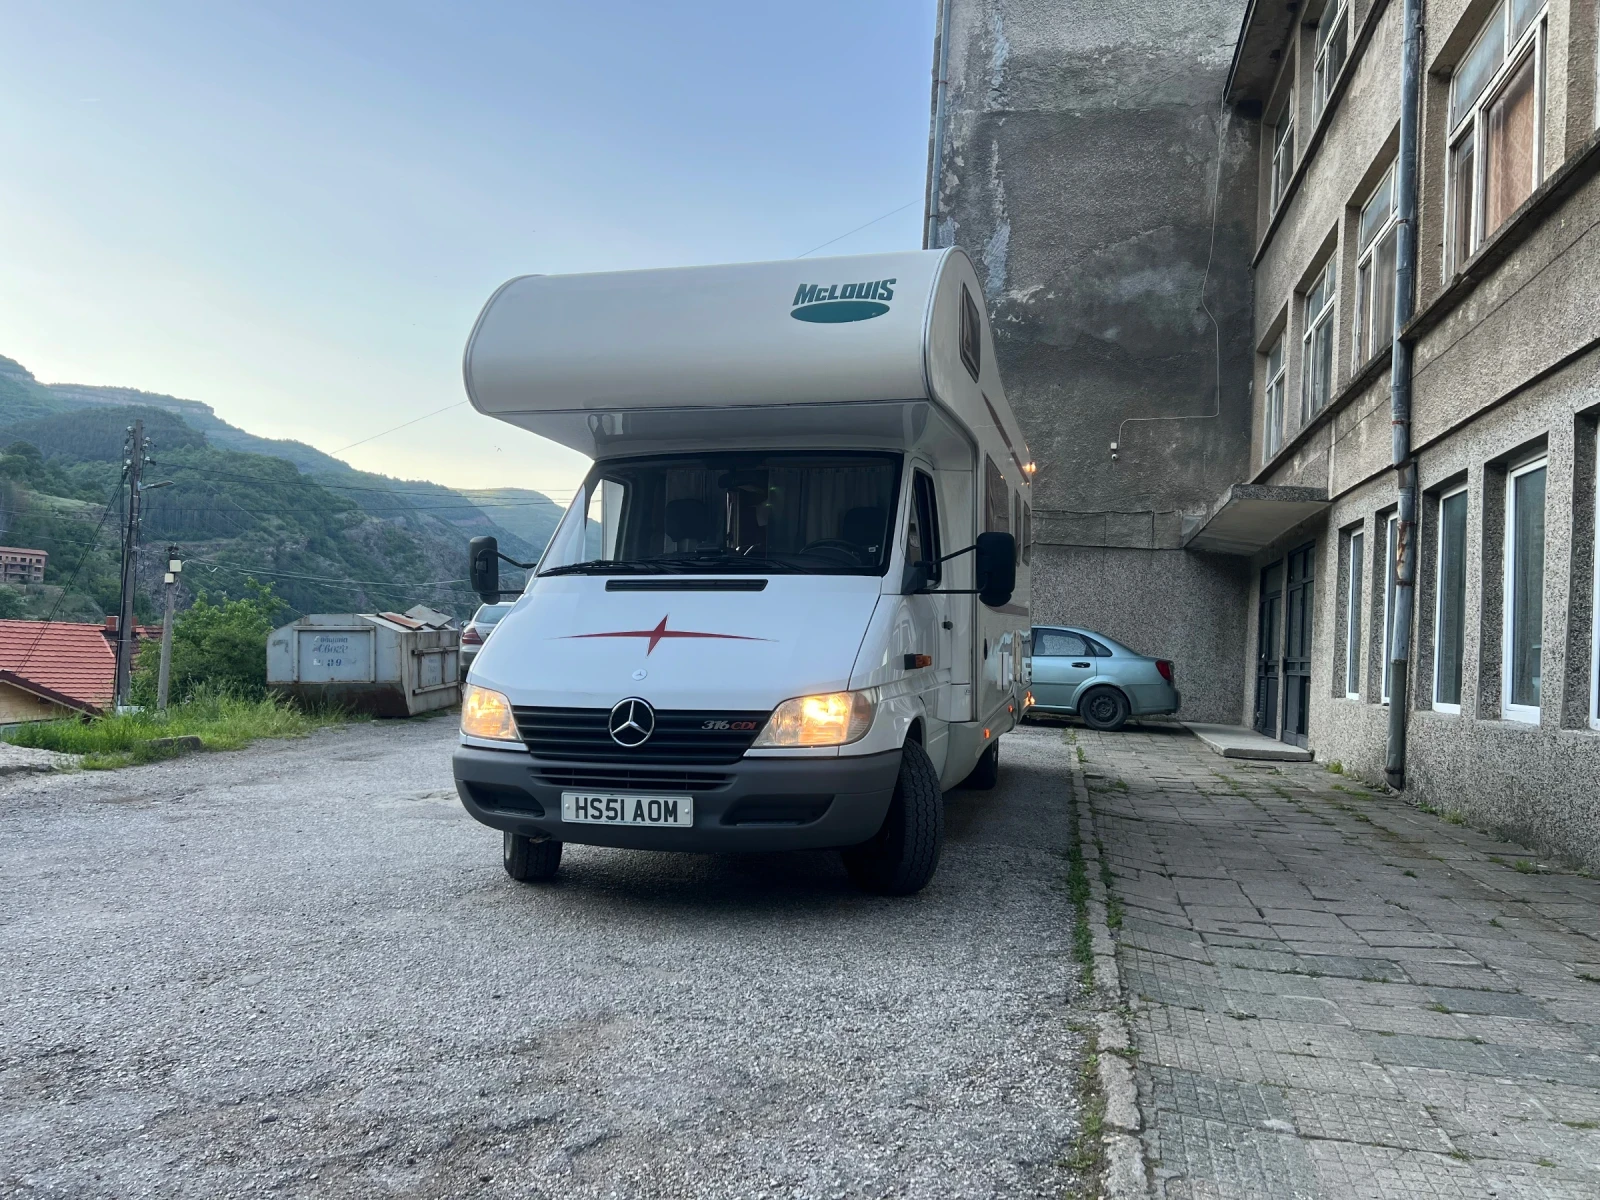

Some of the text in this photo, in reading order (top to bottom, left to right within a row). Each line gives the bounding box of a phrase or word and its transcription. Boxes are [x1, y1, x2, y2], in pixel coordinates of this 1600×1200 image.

[701, 720, 757, 730] 316 CDI
[575, 796, 678, 823] HS51 AOM
